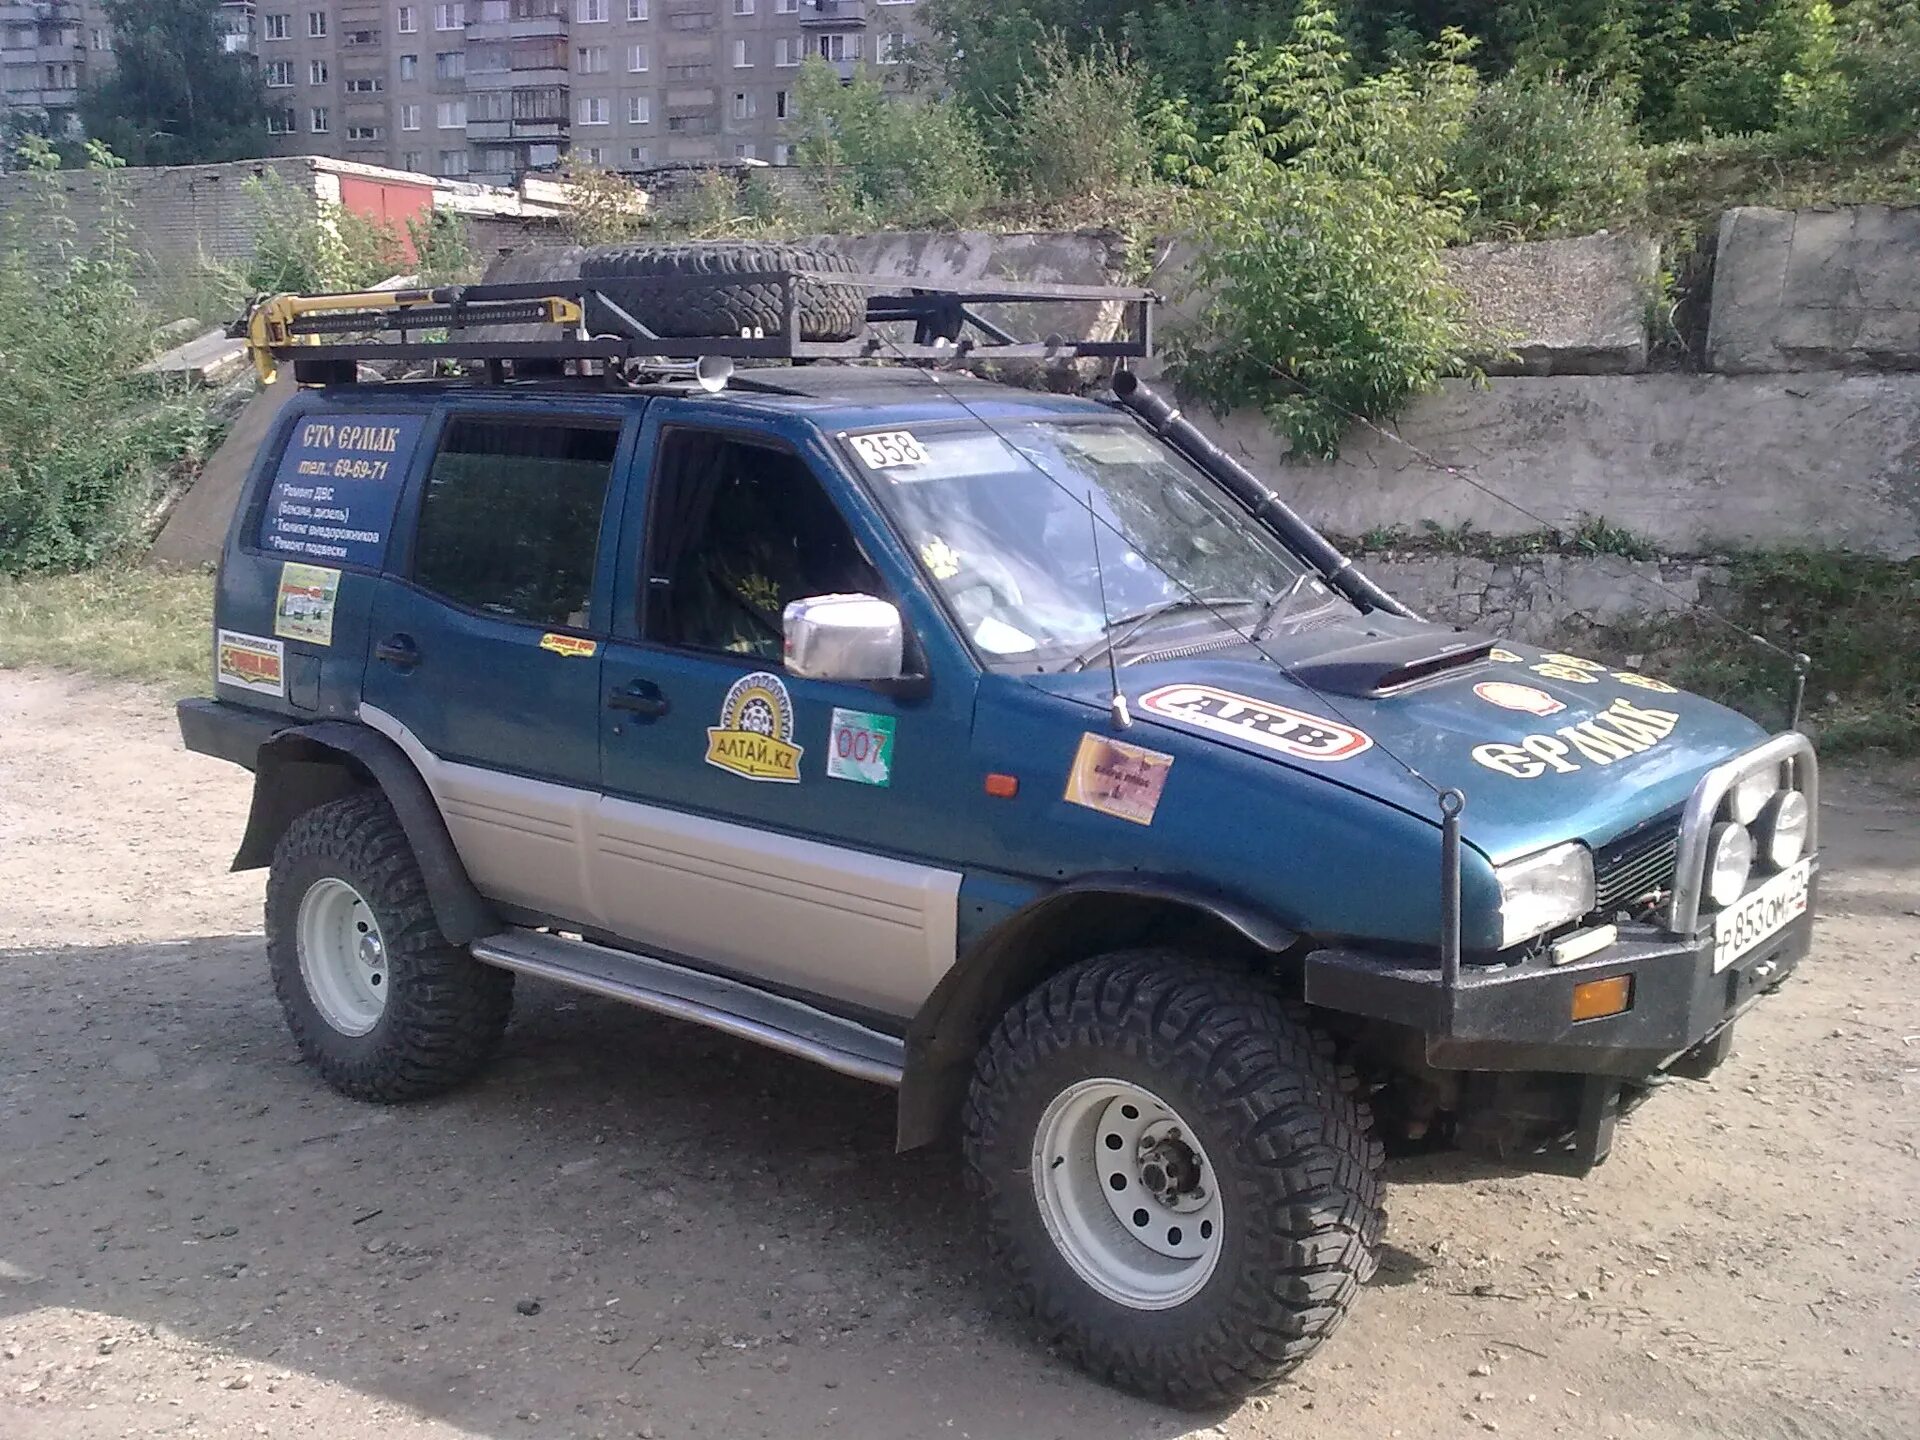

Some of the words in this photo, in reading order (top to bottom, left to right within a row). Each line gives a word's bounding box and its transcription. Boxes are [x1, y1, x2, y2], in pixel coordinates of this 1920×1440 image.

[303, 424, 335, 449] СТО
[860, 434, 921, 465] 358
[334, 458, 389, 480] 69-69-71
[314, 486, 335, 501] ДВС
[1168, 695, 1339, 748] ARB
[716, 738, 793, 770] АЛТАЙ.KZ
[837, 727, 888, 764] 007
